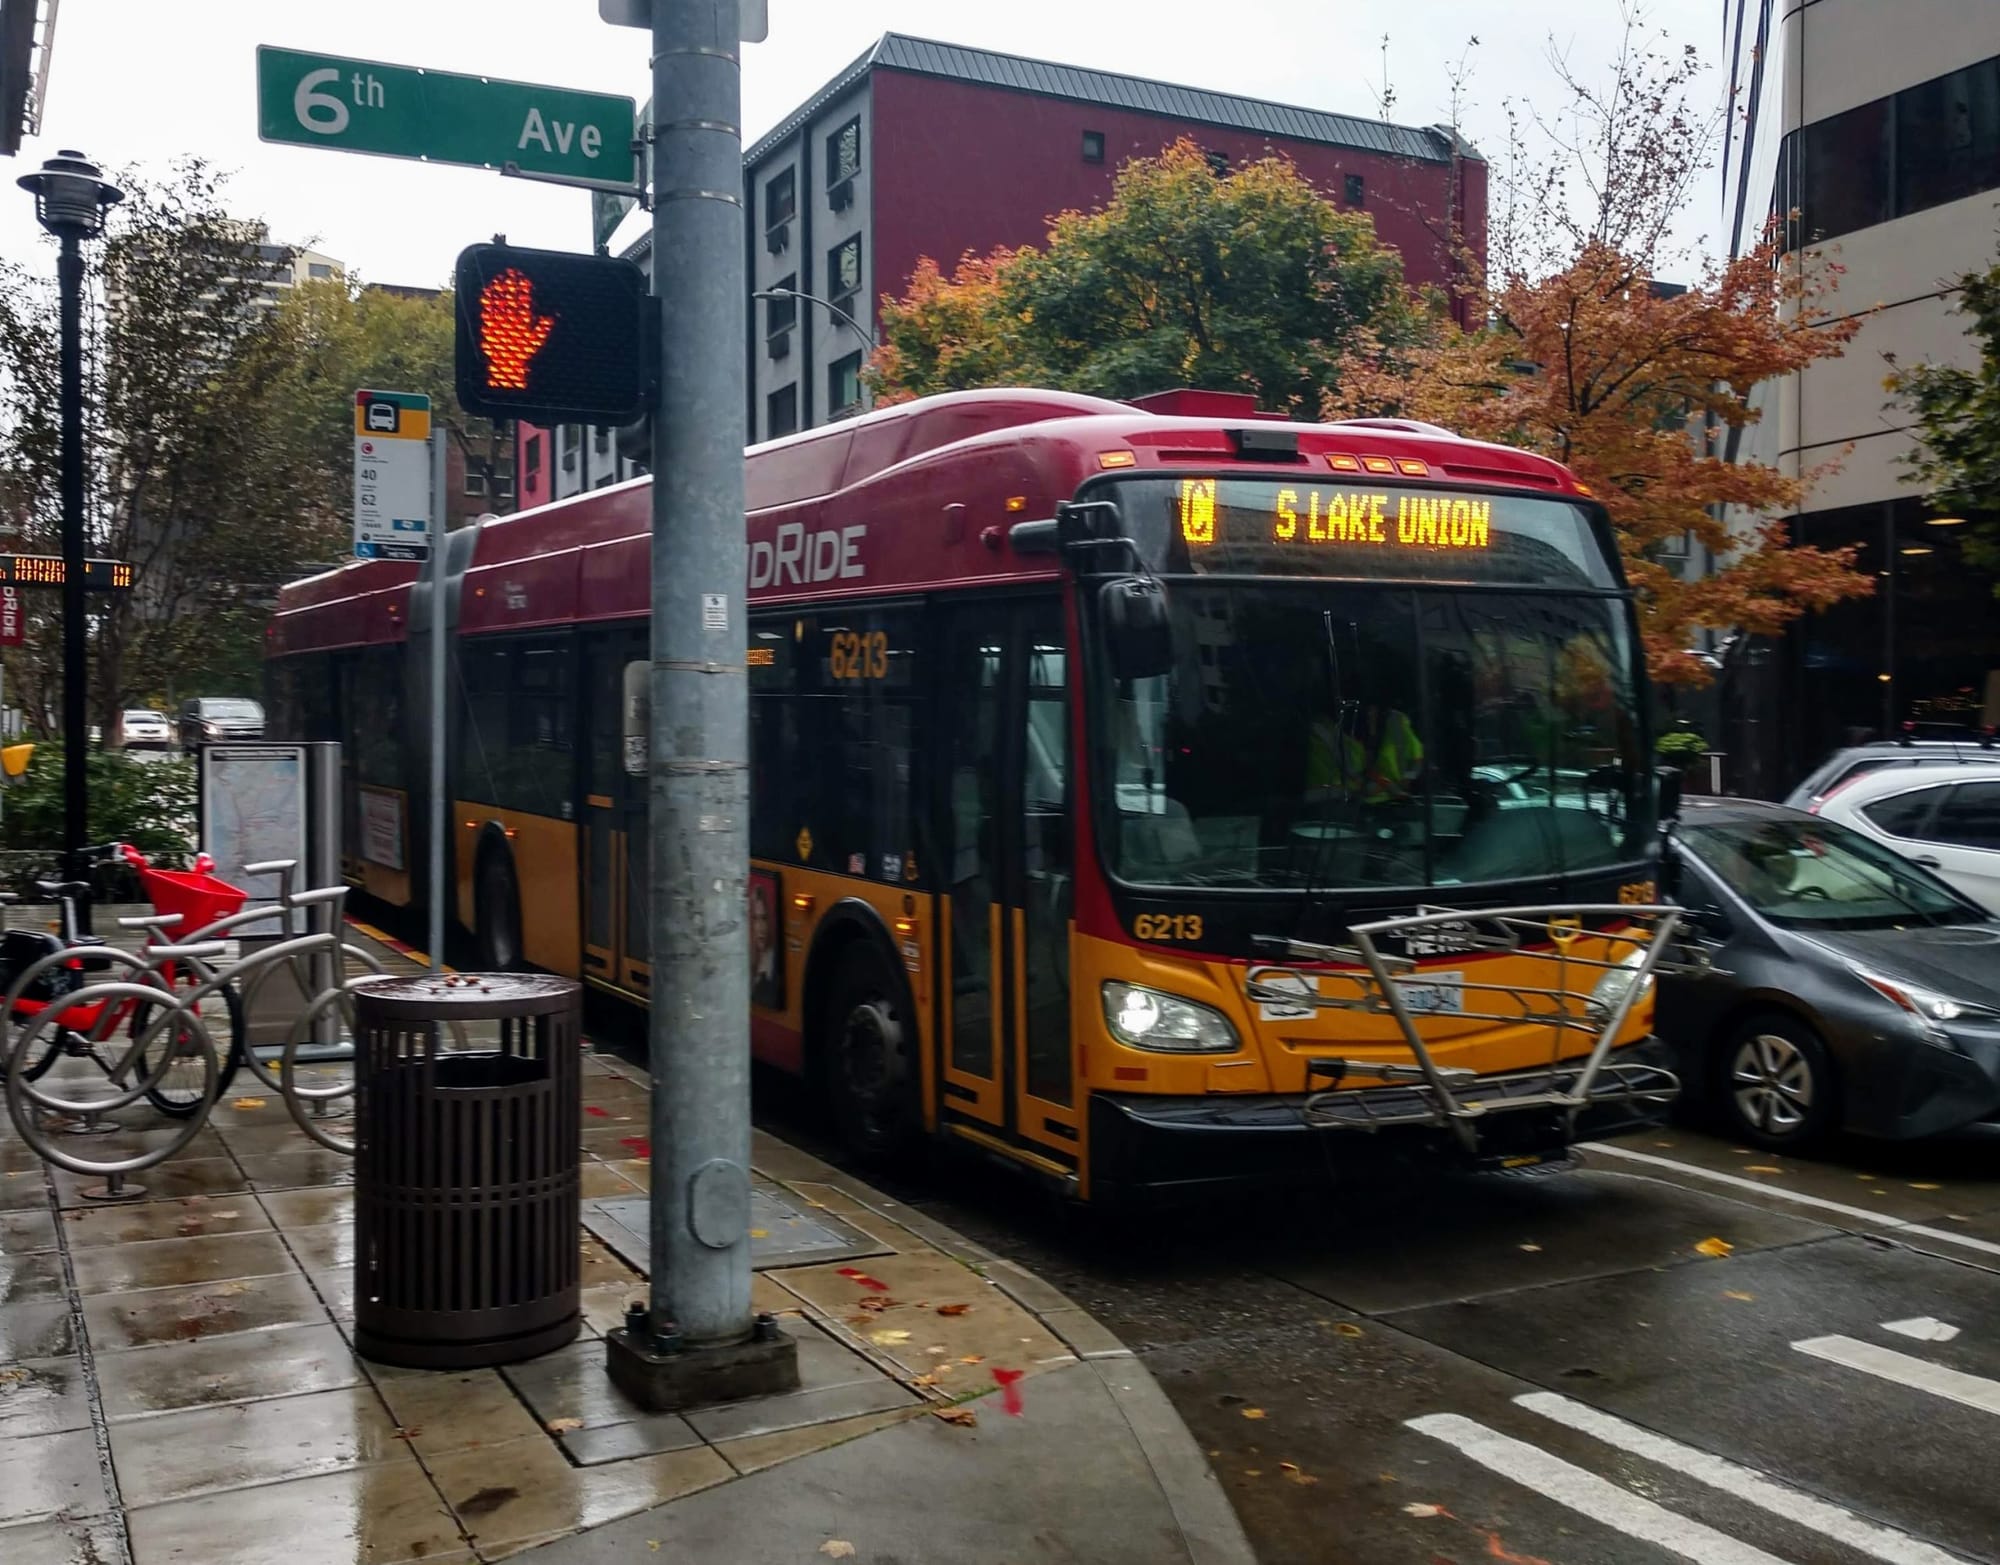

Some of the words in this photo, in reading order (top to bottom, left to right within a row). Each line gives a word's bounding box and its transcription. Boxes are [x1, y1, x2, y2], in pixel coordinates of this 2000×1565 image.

[294, 68, 385, 135] 6th
[517, 108, 602, 159] Ave
[361, 470, 377, 480] 40
[361, 495, 377, 506] 62
[1275, 489, 1298, 541] S
[1308, 491, 1388, 543] LAKE
[1398, 496, 1490, 547] UNION
[746, 522, 867, 589] DRIDE
[831, 631, 888, 679] 6213
[1134, 914, 1203, 940] 6213
